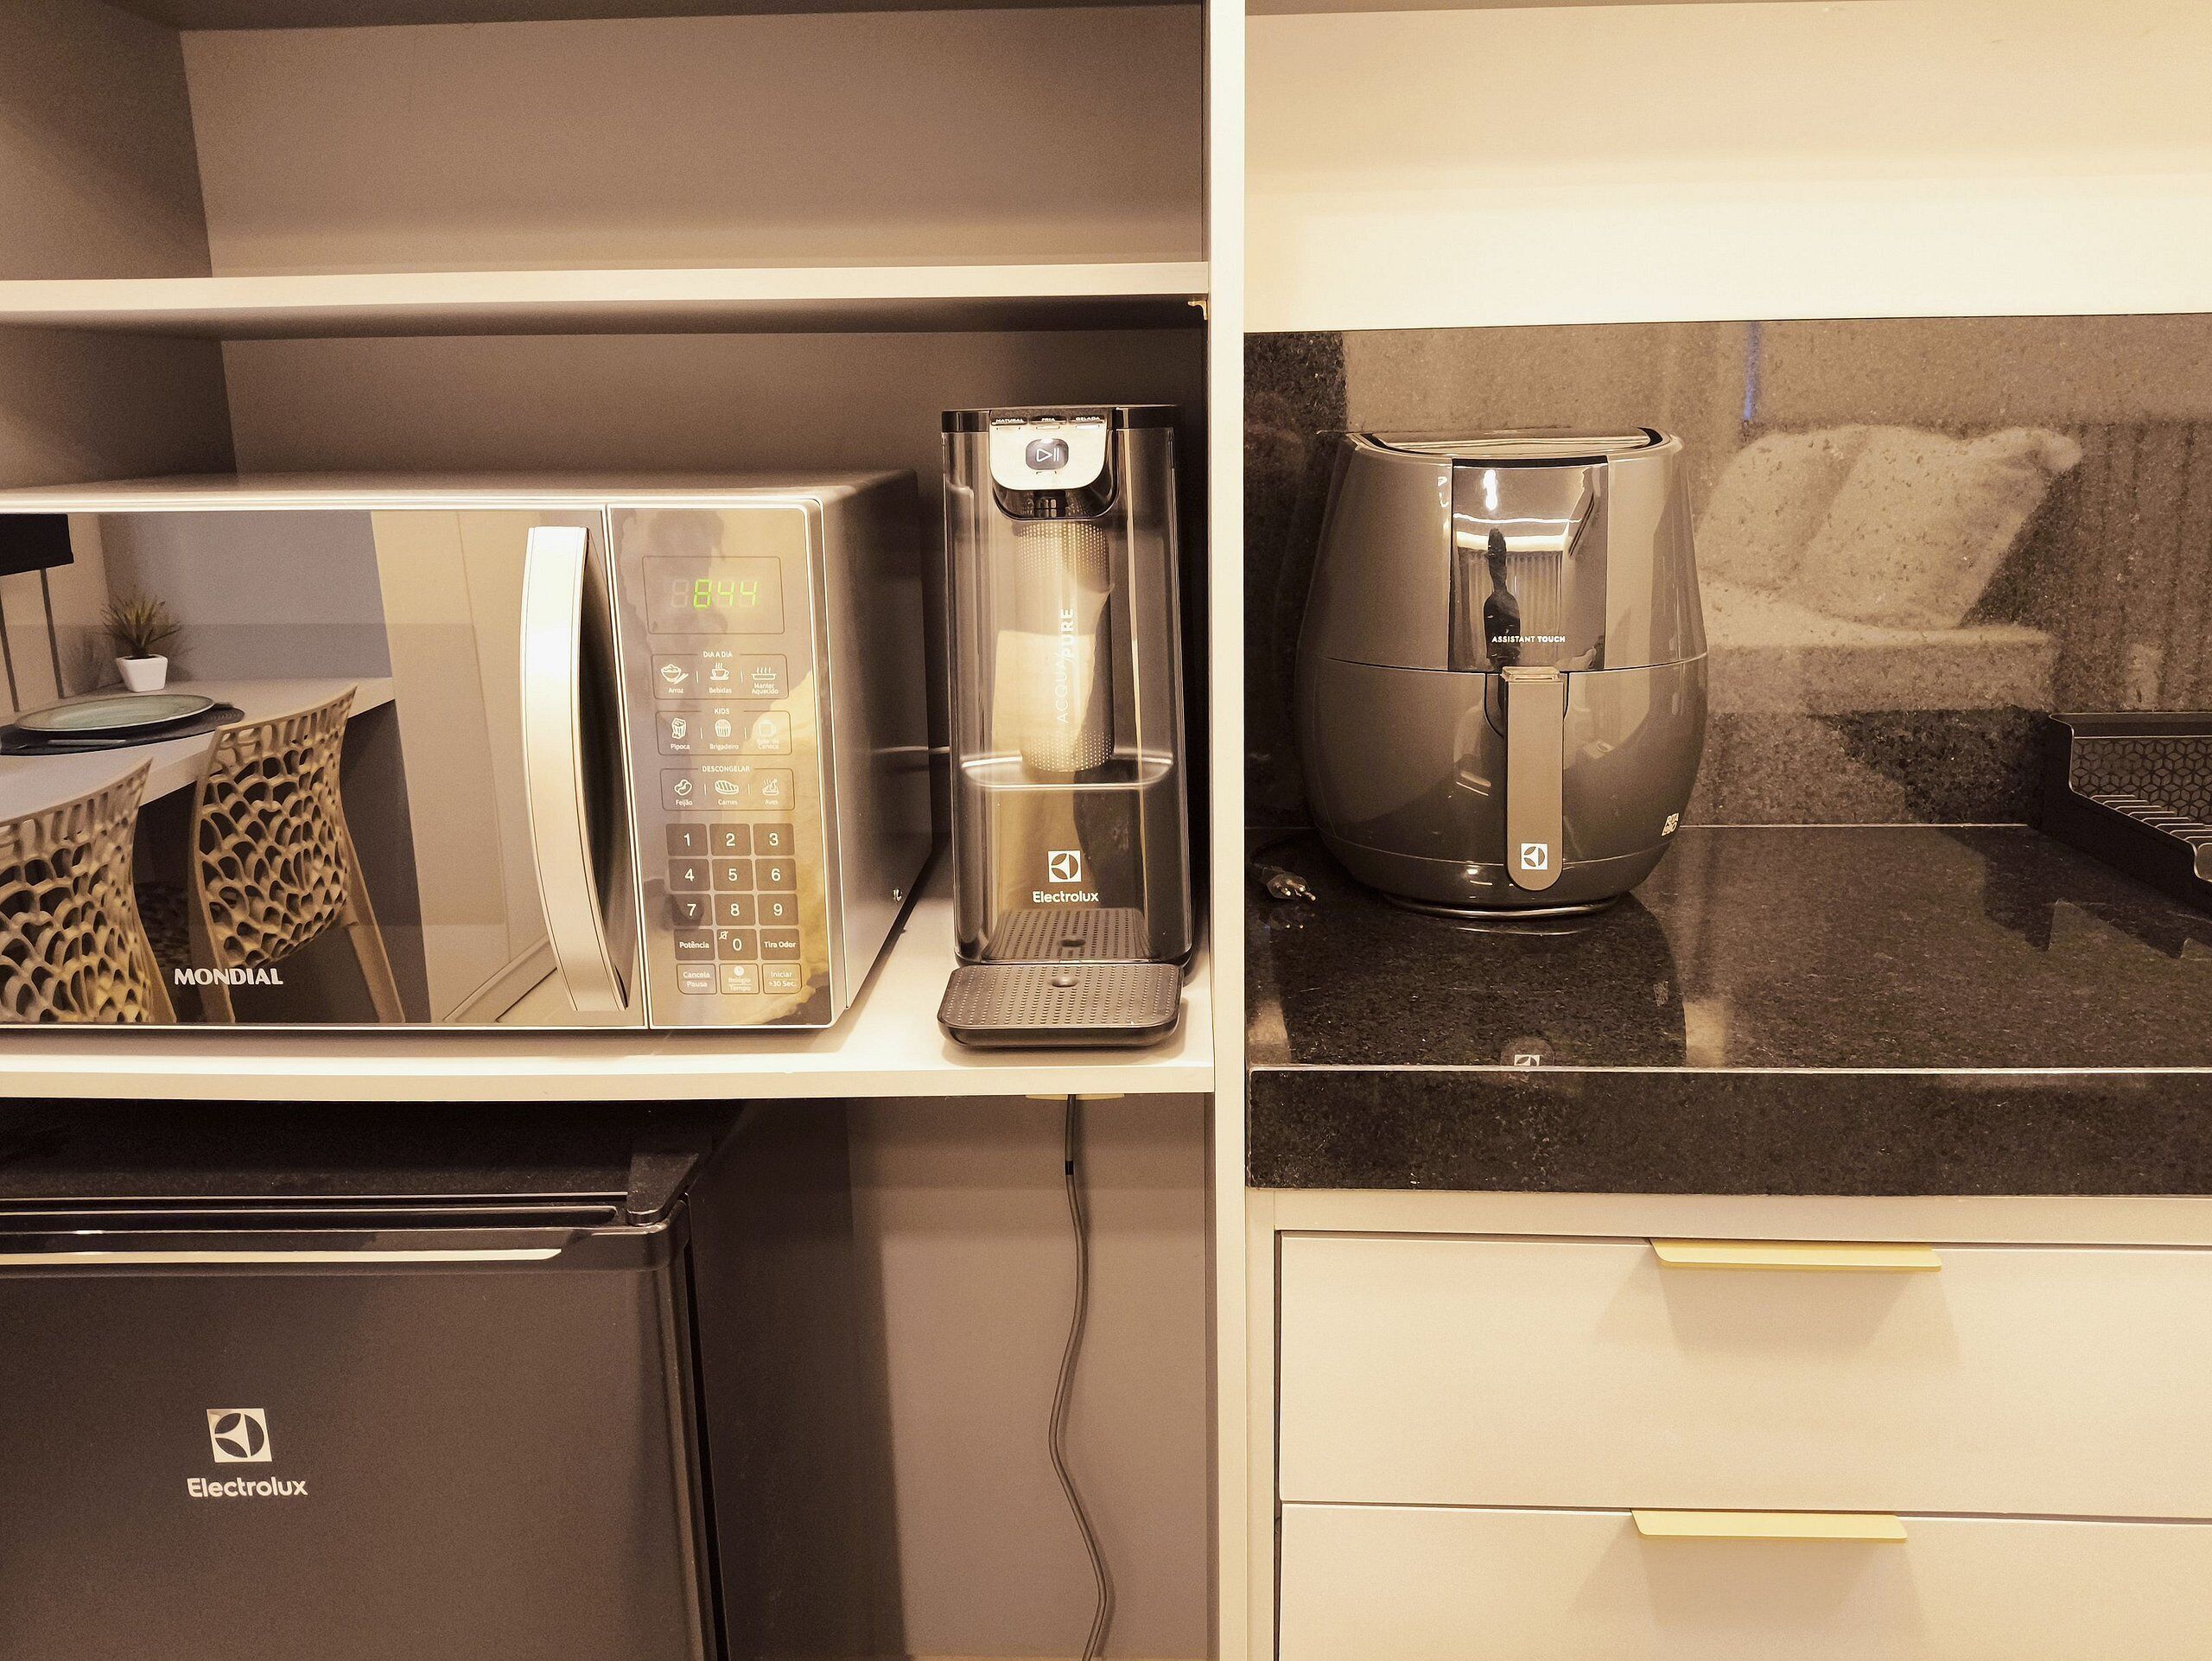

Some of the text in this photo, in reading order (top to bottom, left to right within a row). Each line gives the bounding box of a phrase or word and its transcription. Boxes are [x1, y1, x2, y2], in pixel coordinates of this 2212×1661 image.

[683, 832, 690, 847] 1
[725, 832, 736, 847] 2
[769, 832, 779, 846] 3
[684, 868, 695, 881] 4
[728, 868, 738, 881] 5
[771, 868, 781, 881] 6
[1032, 890, 1099, 903] Electrolux
[687, 903, 697, 917] 7
[730, 903, 741, 917] 8
[772, 903, 783, 917] 9
[679, 940, 710, 949] Potência
[732, 938, 742, 951] 0
[174, 968, 284, 985] MONDIAL
[187, 1476, 308, 1498] Electrolux
